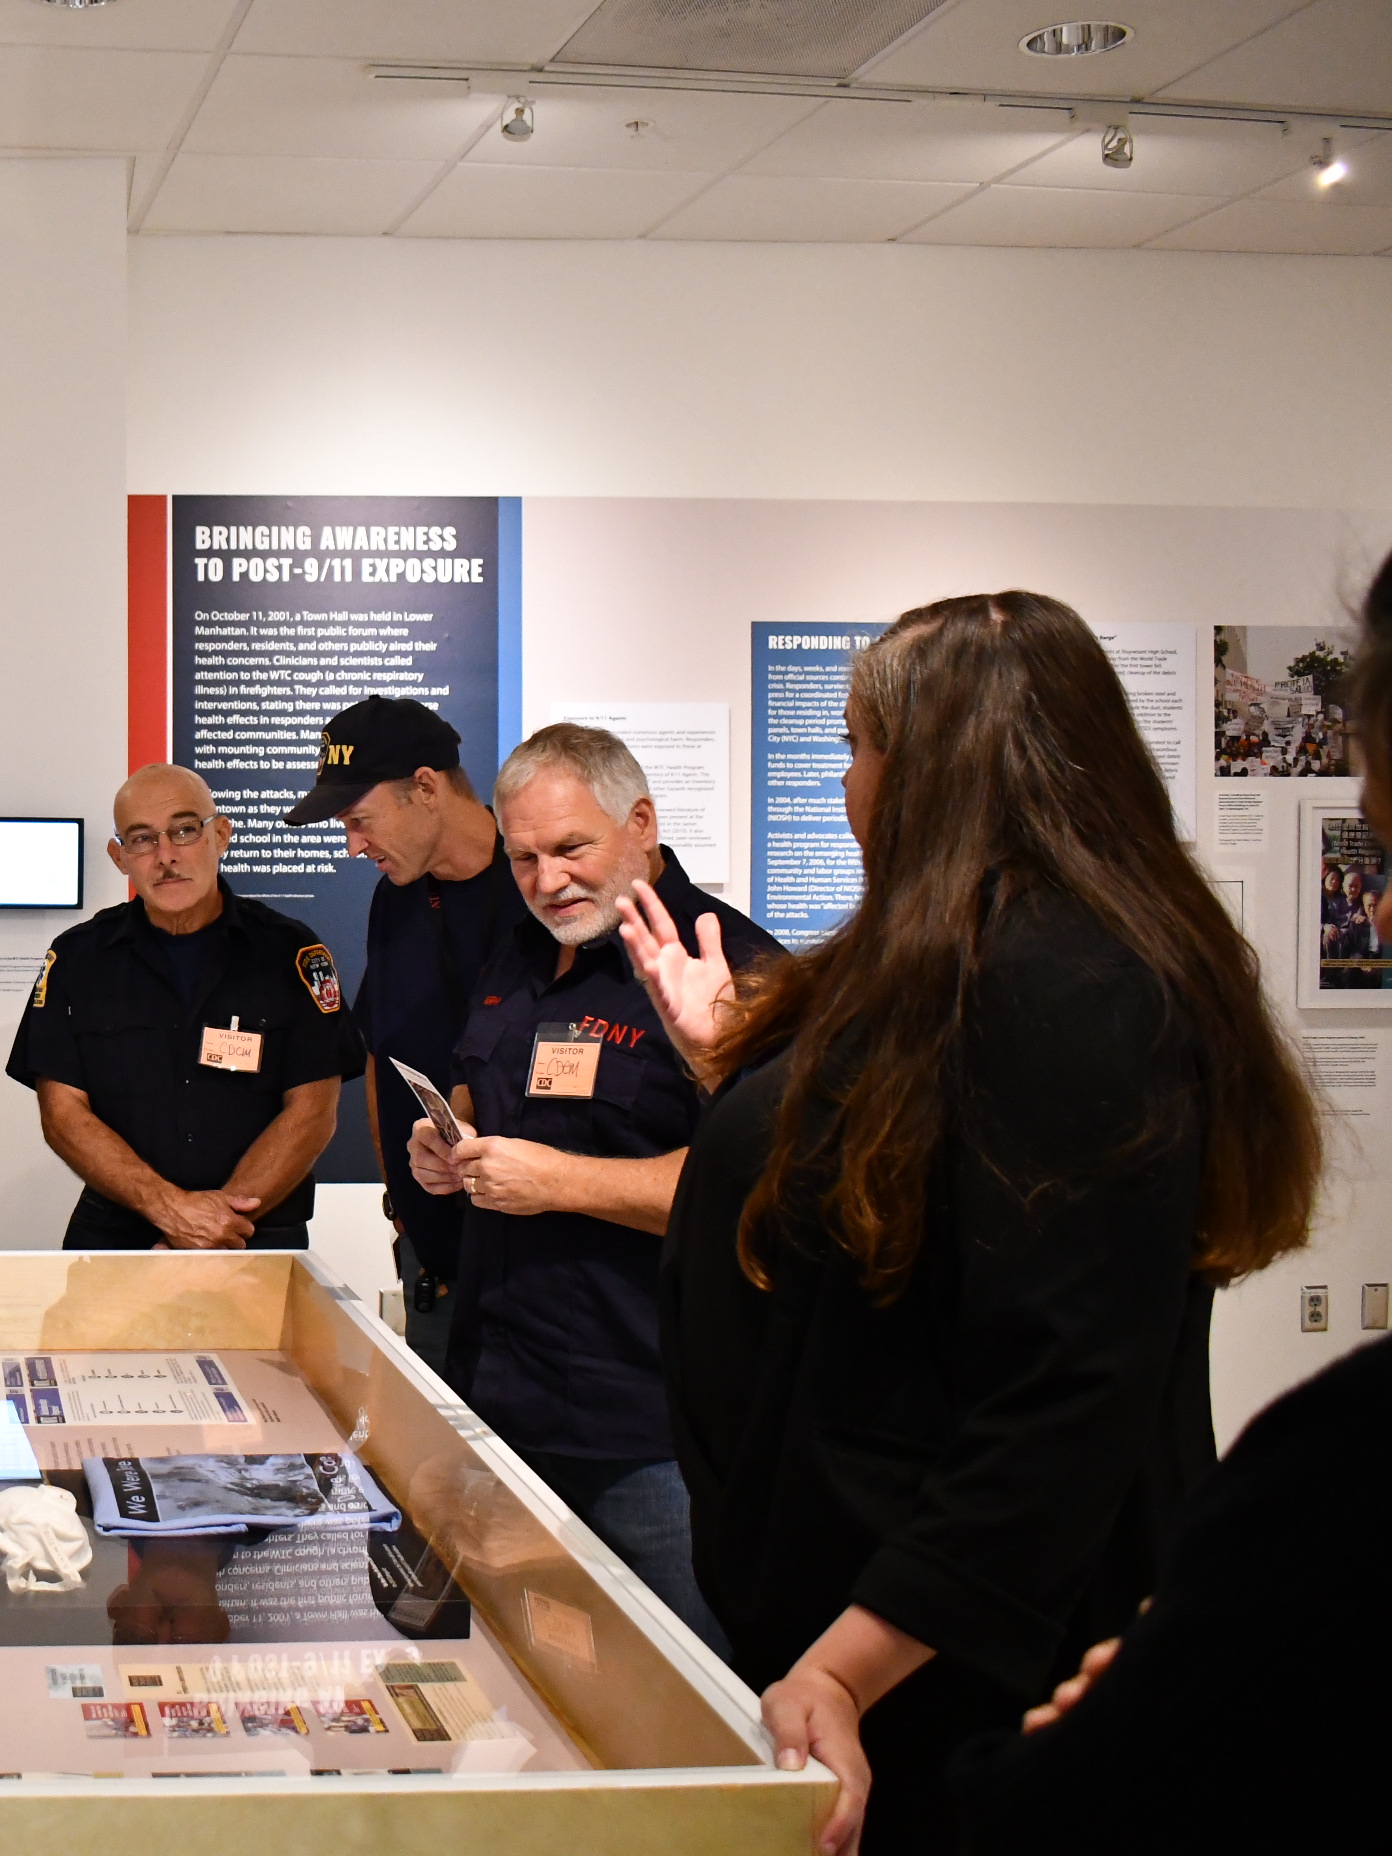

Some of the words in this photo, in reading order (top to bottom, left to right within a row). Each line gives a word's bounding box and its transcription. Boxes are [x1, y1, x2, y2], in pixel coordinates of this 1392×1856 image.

[196, 526, 311, 550] BRINGING
[320, 526, 456, 551] AWARENESS
[195, 558, 223, 582] TO
[233, 558, 352, 582] POST-9/11
[362, 558, 483, 582] EXPOSURE
[195, 611, 209, 621] On
[211, 611, 250, 621] October
[253, 611, 266, 623] 11,
[268, 611, 293, 623] 2001,
[302, 611, 328, 621] Town
[330, 611, 348, 621] Hall
[370, 611, 391, 621] held
[393, 611, 402, 621] in
[404, 611, 433, 622] Lower
[195, 626, 248, 635] Manhattan.
[250, 626, 257, 635] It
[259, 628, 278, 636] was
[279, 626, 295, 636] the
[297, 626, 315, 636] first
[317, 626, 347, 637] public
[348, 626, 377, 636] forum
[378, 626, 409, 636] where
[195, 641, 249, 652] responders,
[252, 641, 296, 651] residents,
[298, 641, 316, 650] and
[318, 641, 348, 650] others
[350, 641, 387, 652] publicly
[389, 641, 413, 651] aired
[414, 641, 437, 651] their
[768, 635, 851, 650] RESPONDING
[195, 655, 225, 665] health
[273, 656, 318, 665] Clinicians
[320, 656, 338, 665] and
[340, 656, 382, 666] scientists
[384, 656, 412, 666] called
[788, 665, 803, 673] days,
[195, 671, 238, 680] attention
[240, 672, 250, 680] to
[252, 670, 268, 680] the
[270, 670, 291, 680] WTC
[293, 670, 323, 682] cough
[325, 671, 334, 680] (a
[336, 670, 371, 680] chronic
[372, 671, 424, 682] respiratory
[195, 685, 227, 695] illness)
[229, 686, 238, 694] in
[240, 685, 293, 697] firefighters.
[294, 685, 317, 697] They
[319, 685, 347, 695] called
[348, 685, 362, 695] for
[364, 686, 429, 697] investigations
[430, 686, 449, 695] and
[195, 700, 259, 710] interventions,
[262, 700, 293, 712] stating
[296, 700, 320, 710] there
[322, 702, 340, 710] was
[768, 736, 781, 744] City
[221, 863, 250, 872] health
[272, 863, 304, 874] placed
[306, 864, 316, 872] at
[317, 863, 336, 872] risk.
[767, 859, 801, 867] September
[579, 1015, 646, 1048] FDNY
[219, 1033, 252, 1042] VISITOR
[552, 1047, 584, 1055] VISITOR
[208, 1054, 222, 1062] CDC
[537, 1079, 552, 1088] CDC
[126, 1495, 148, 1515] We
